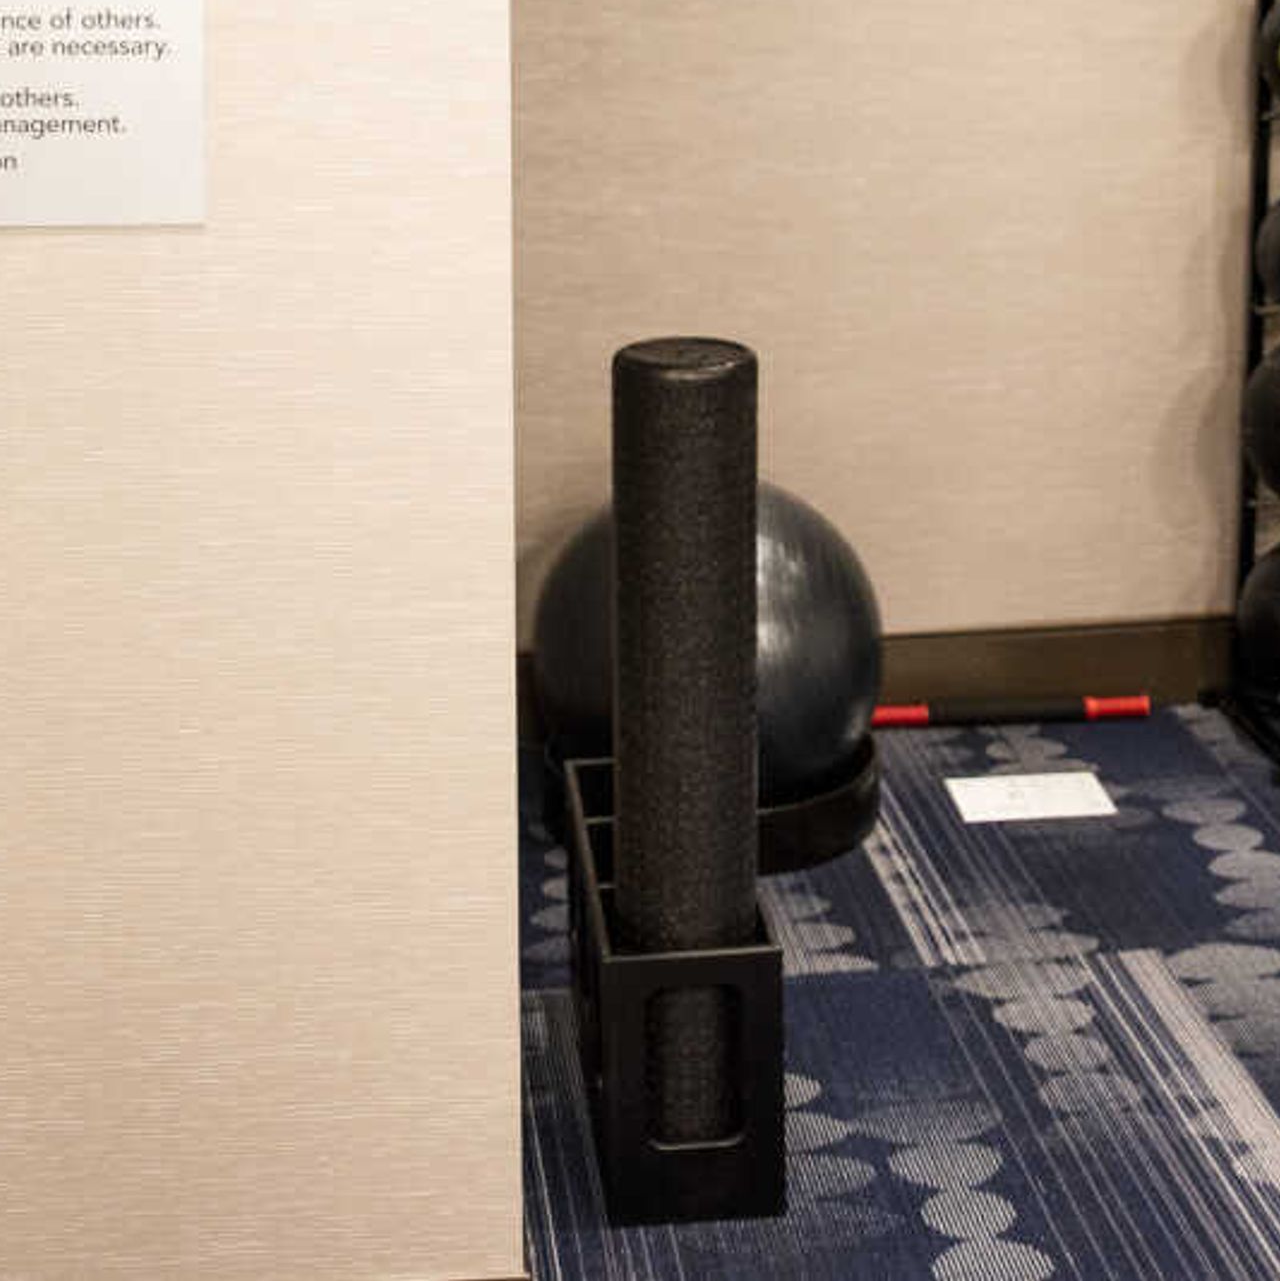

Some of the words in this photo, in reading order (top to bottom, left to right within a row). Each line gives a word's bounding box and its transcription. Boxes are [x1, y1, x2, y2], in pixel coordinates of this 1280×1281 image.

[49, 8, 72, 31] of
[80, 8, 161, 31] others.
[7, 39, 45, 57] are
[51, 38, 172, 61] necessary.
